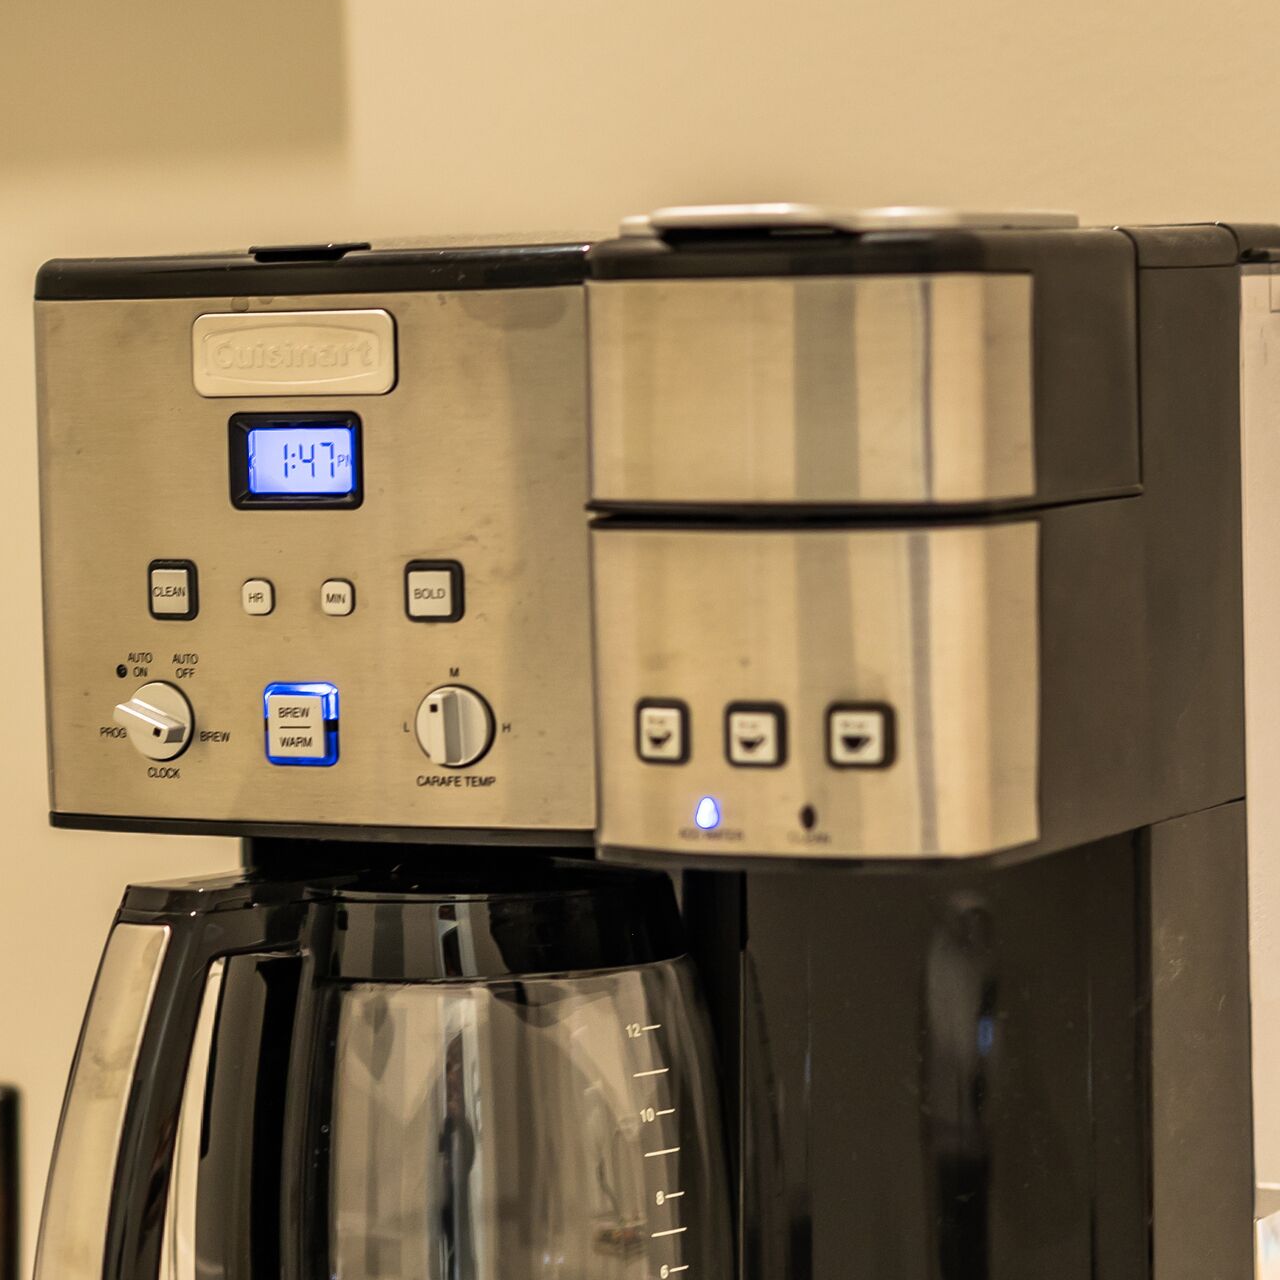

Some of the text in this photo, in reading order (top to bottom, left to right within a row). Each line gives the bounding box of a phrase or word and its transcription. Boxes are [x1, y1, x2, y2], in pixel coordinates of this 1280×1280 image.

[213, 339, 374, 370] Cuisinart
[283, 442, 335, 478] 1:47
[152, 585, 186, 598] CLEAN
[248, 592, 264, 603] HR
[414, 588, 446, 600] BOLD
[326, 593, 346, 604] MIN
[128, 652, 153, 664] AUTO
[172, 653, 199, 665] AUTO
[133, 666, 148, 678] ON
[175, 667, 195, 679] OFF
[449, 667, 460, 678] M
[278, 706, 310, 719] BREW
[100, 727, 128, 739] PROG
[403, 721, 410, 733] L
[502, 723, 512, 733] H
[200, 730, 231, 742] BREW
[279, 736, 313, 748] WARM
[147, 766, 181, 779] CLOCK
[416, 775, 497, 788] CARAFE TEMP
[625, 1022, 642, 1039] 12
[639, 1106, 655, 1123] 10
[655, 1190, 665, 1206] 8
[660, 1264, 669, 1280] 6
